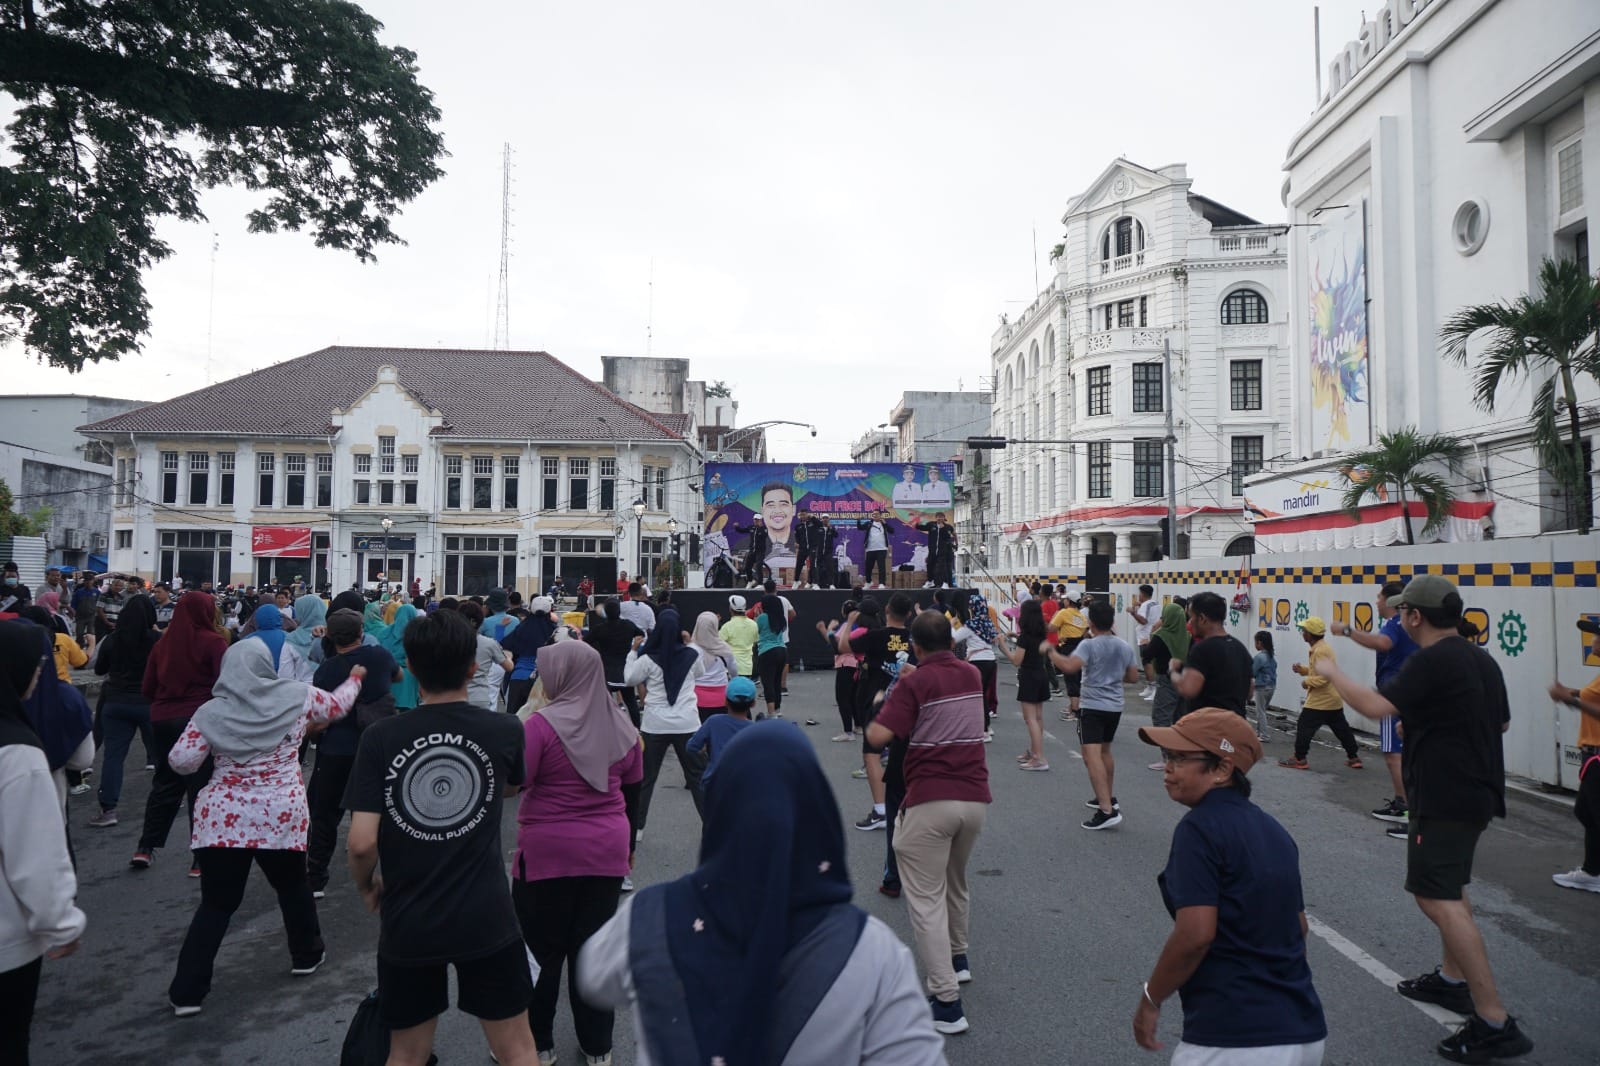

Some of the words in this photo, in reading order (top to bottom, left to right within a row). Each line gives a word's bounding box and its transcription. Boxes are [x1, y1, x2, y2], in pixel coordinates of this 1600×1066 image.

[809, 500, 832, 511] CAR
[834, 500, 862, 511] FREE
[864, 499, 887, 511] DAY
[1283, 490, 1319, 510] mandiri
[384, 732, 464, 781] VOLCOM
[465, 740, 489, 762] TRUE
[485, 761, 494, 776] TO
[384, 785, 395, 808] THE
[485, 776, 495, 802] THIS
[388, 807, 445, 841] IRRATIONAL
[446, 806, 488, 841] PURSUIT
